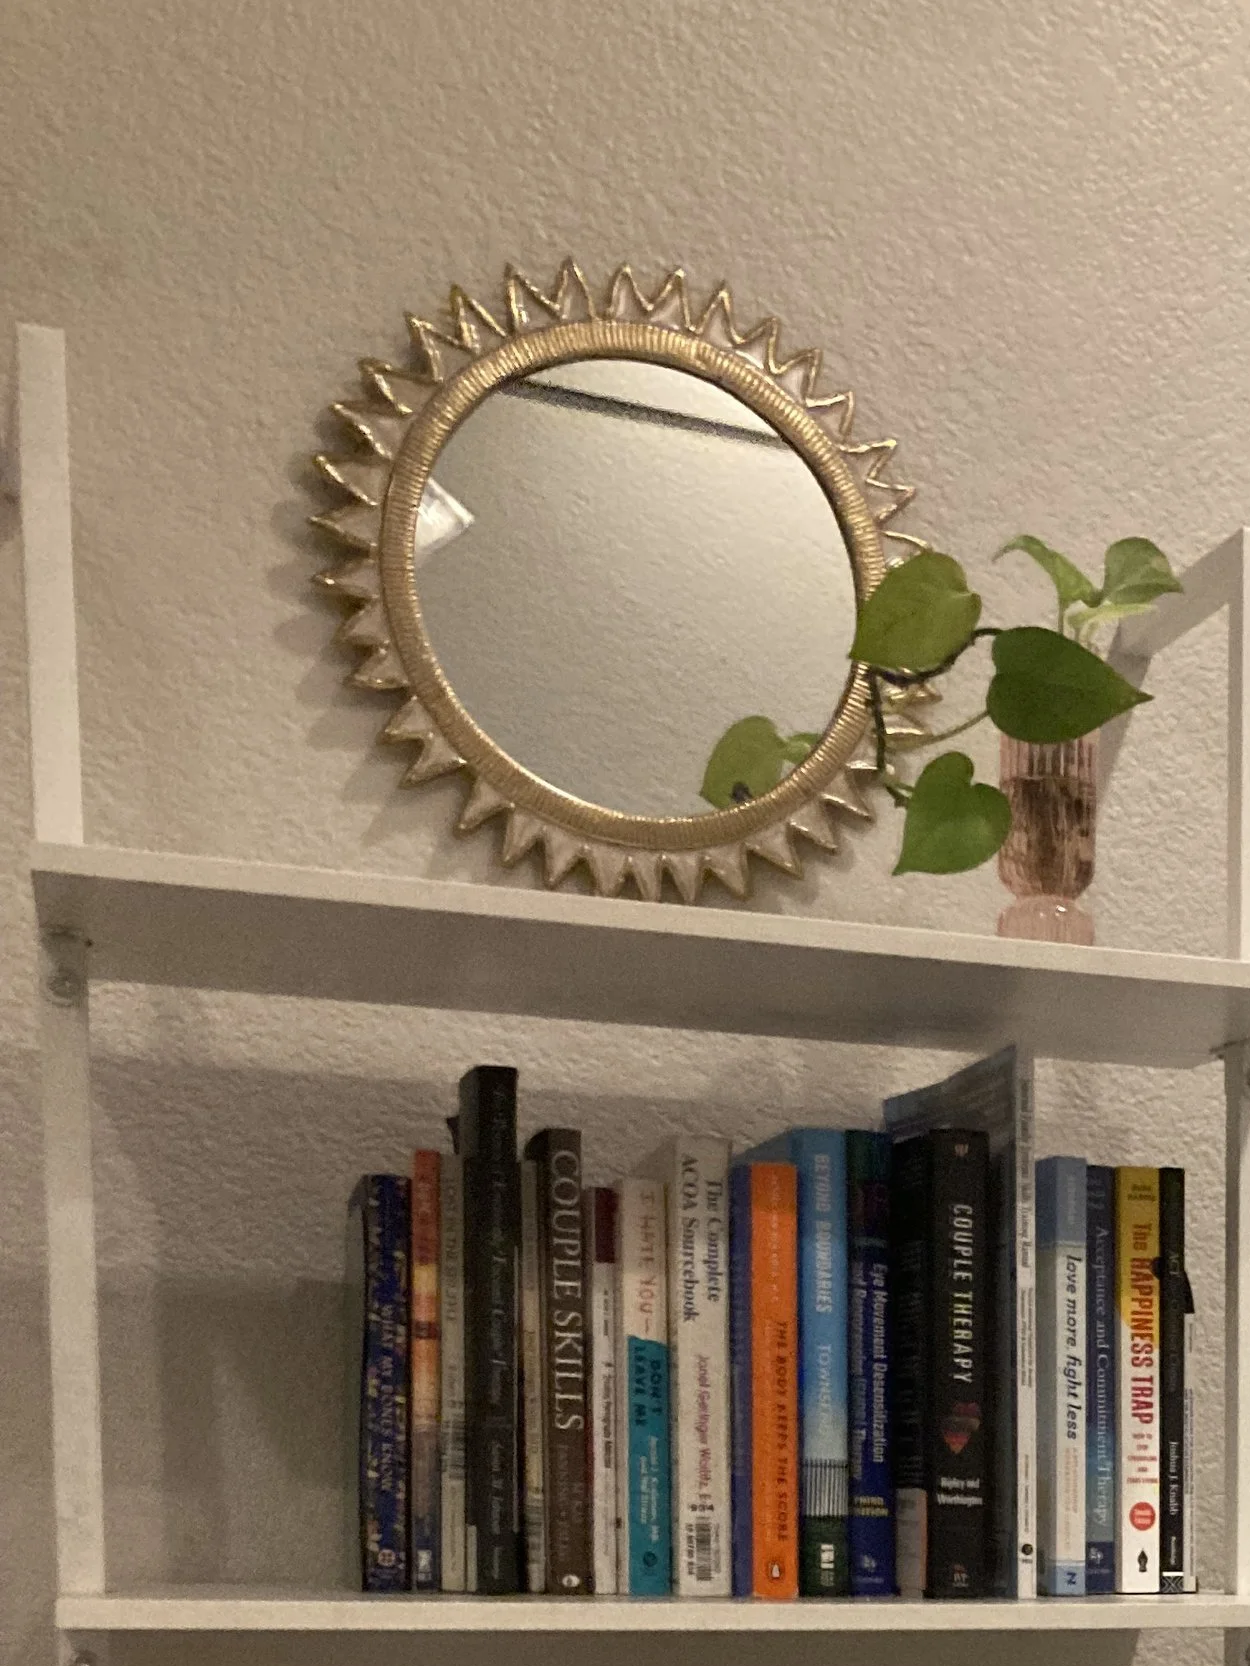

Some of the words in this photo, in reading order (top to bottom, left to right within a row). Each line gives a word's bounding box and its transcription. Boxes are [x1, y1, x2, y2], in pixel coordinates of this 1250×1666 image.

[682, 1153, 699, 1211] ACOA
[706, 1179, 723, 1211] The
[813, 1153, 832, 1213] BEYOND
[552, 1150, 582, 1299] COUPLE
[639, 1216, 656, 1265] HATE
[952, 1203, 974, 1282] COUPLE
[1131, 1222, 1153, 1253] The
[682, 1216, 700, 1323] Sourcebook
[704, 1217, 724, 1303] Complete
[815, 1219, 834, 1314] BOUNDARIES
[870, 1263, 888, 1288] Eye
[1066, 1254, 1082, 1294] love
[1092, 1225, 1110, 1316] Acceptance
[380, 1303, 395, 1349] WHAT
[775, 1321, 789, 1350] THE
[872, 1289, 889, 1358] Movement
[952, 1290, 974, 1384] THERAPY
[1096, 1320, 1111, 1349] and
[1129, 1257, 1155, 1369] HAPPINESS
[380, 1355, 395, 1377] MY
[554, 1308, 584, 1431] SKILLS
[634, 1346, 647, 1396] LEAVE
[699, 1354, 712, 1389] Janet
[775, 1355, 789, 1396] BODY
[1063, 1353, 1084, 1399] fight
[380, 1384, 395, 1437] BONES
[634, 1403, 649, 1427] ME
[872, 1362, 889, 1464] Desensitization
[1066, 1403, 1083, 1441] less
[1096, 1353, 1111, 1461] Commitment
[1131, 1373, 1155, 1425] TRAP
[775, 1403, 789, 1450] KEEPS
[380, 1442, 395, 1491] KNOW
[775, 1457, 789, 1485] THE
[1169, 1440, 1181, 1474] Joshua
[775, 1491, 789, 1542] SCORE
[1093, 1466, 1113, 1528] Therapy
[1169, 1483, 1181, 1516] Knabb
